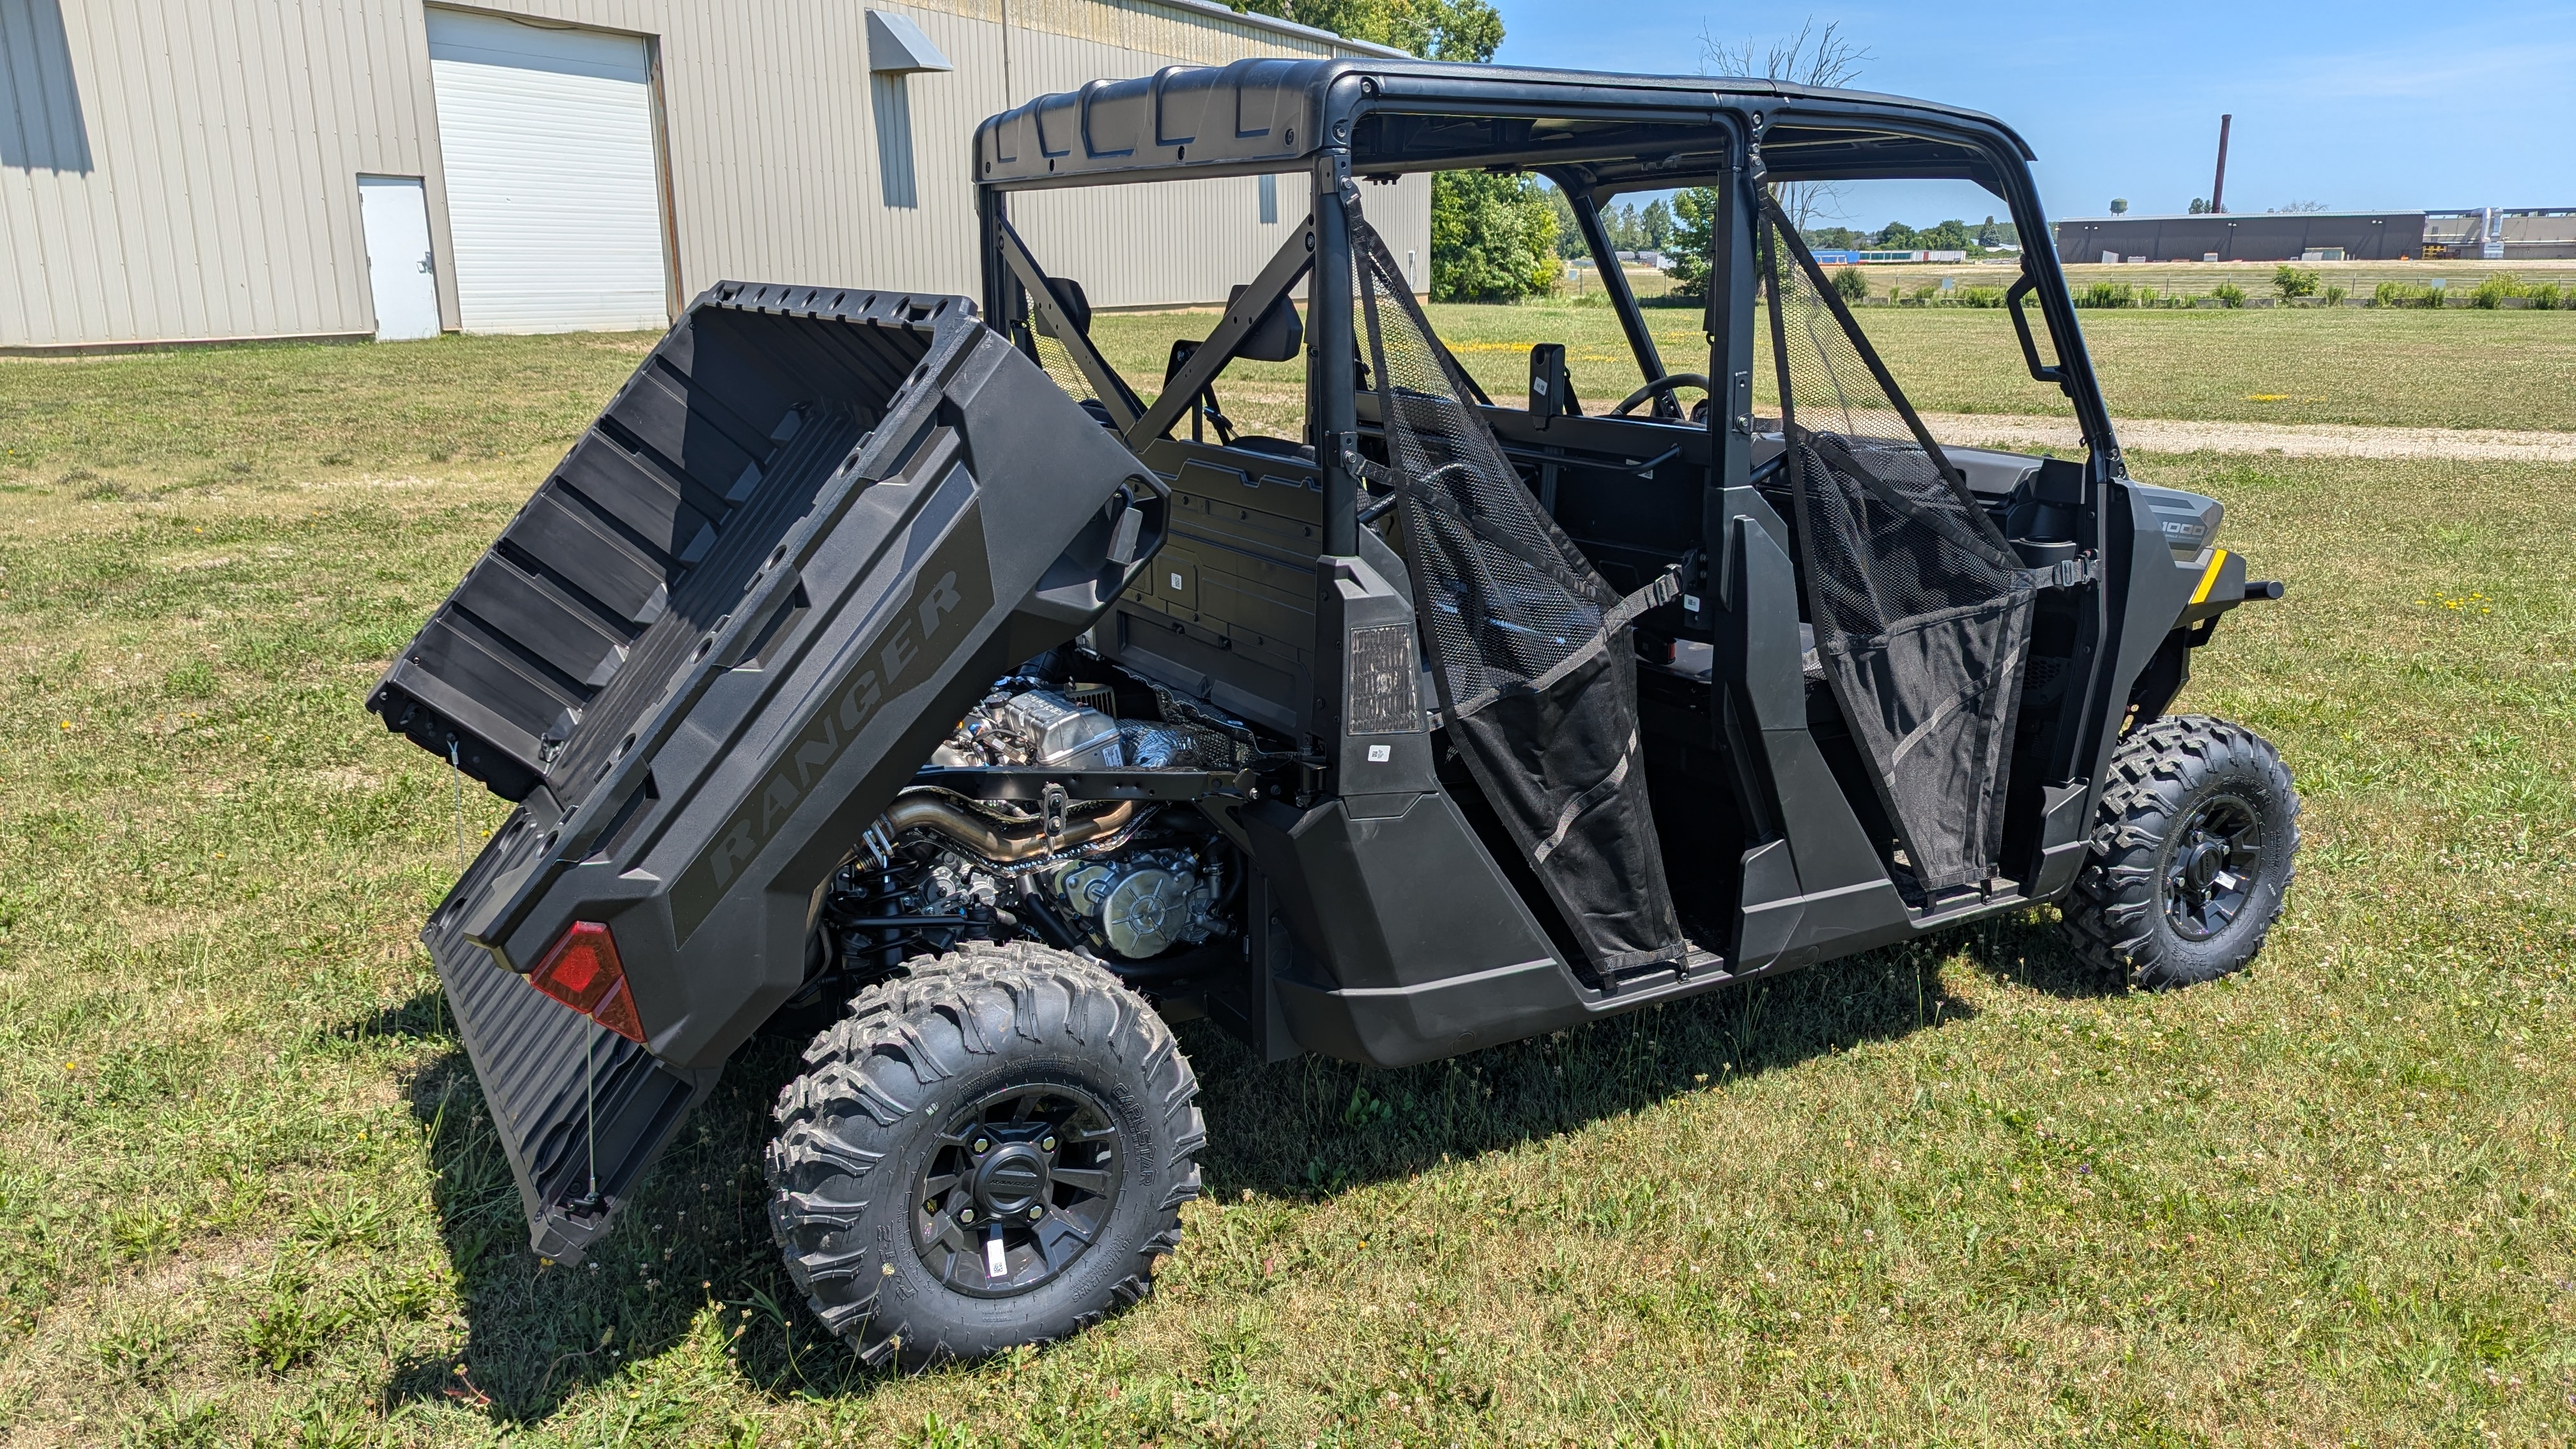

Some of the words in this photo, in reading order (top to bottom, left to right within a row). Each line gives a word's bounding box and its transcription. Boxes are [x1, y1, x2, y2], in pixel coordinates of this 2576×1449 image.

[2162, 521, 2205, 536] 1000
[709, 570, 961, 889] RANGER
[1112, 1082, 1154, 1186] CARLSTAR
[989, 1179, 1038, 1188] RANGER
